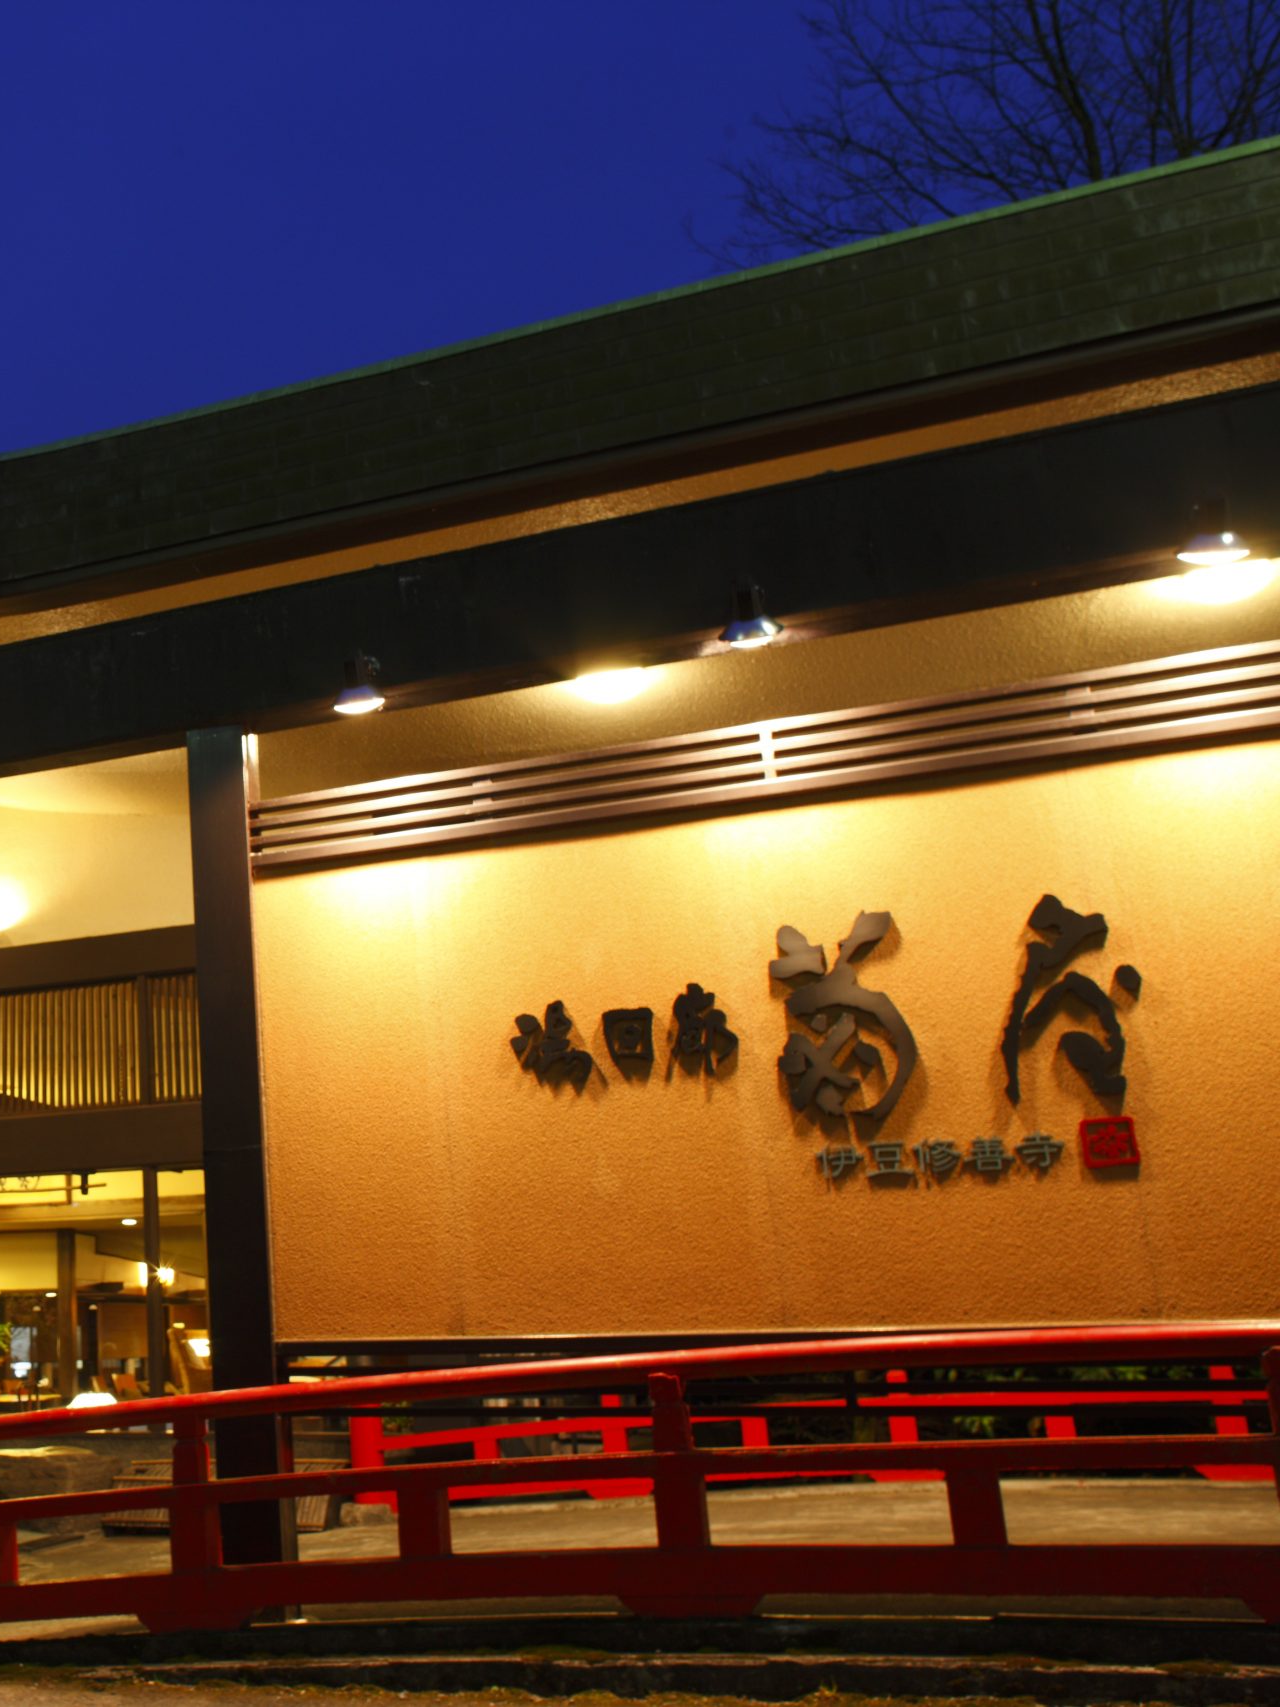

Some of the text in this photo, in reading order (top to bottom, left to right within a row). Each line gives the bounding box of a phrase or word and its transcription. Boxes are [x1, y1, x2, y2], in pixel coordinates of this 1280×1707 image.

[816, 1131, 1065, 1178] 伊豆修善寺
